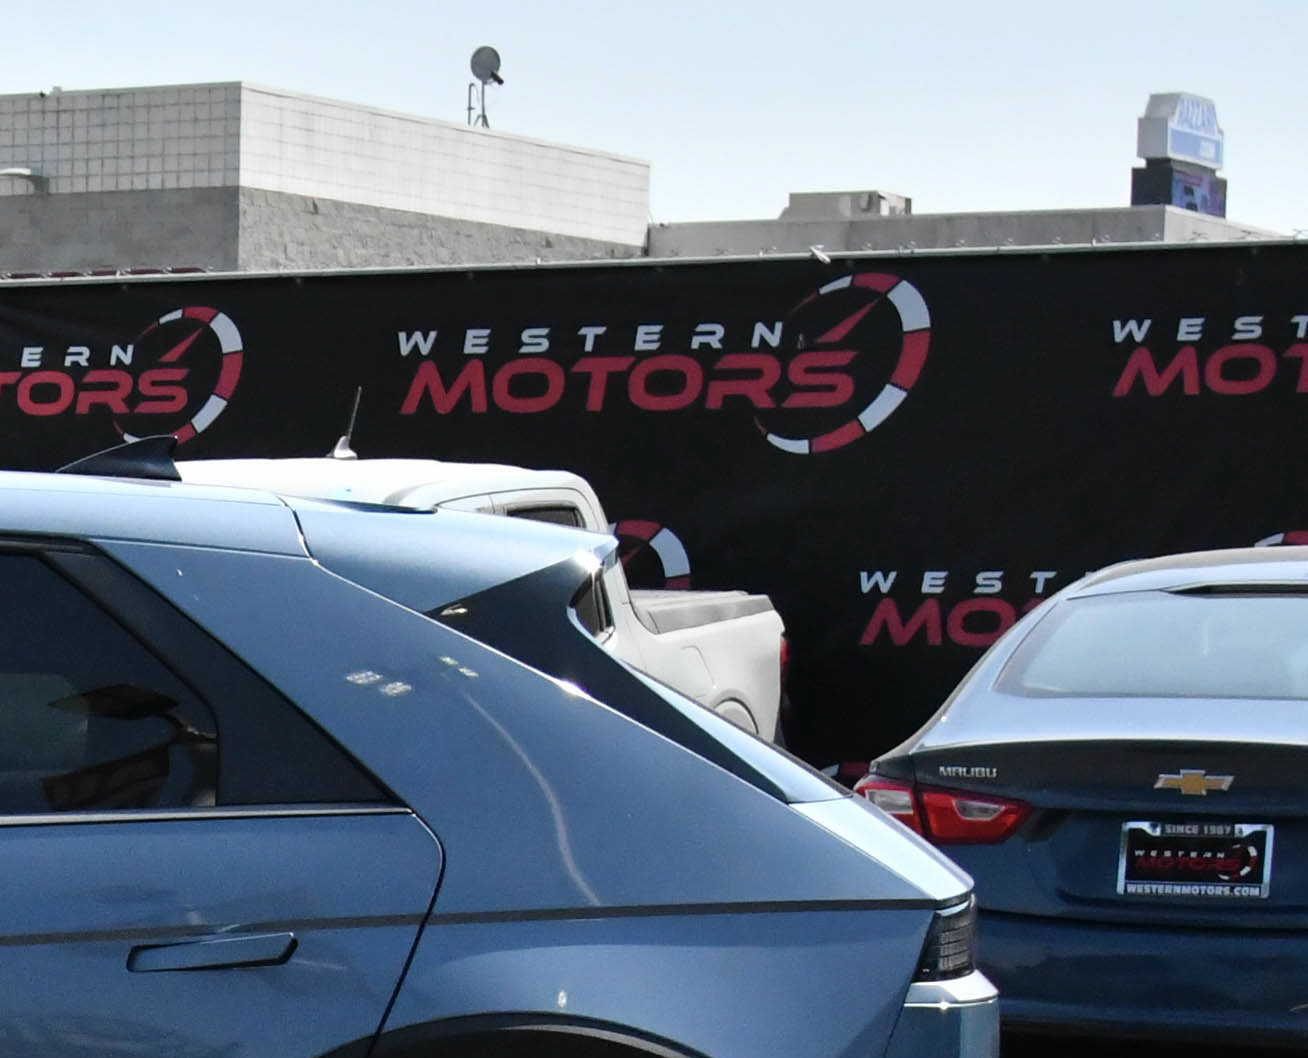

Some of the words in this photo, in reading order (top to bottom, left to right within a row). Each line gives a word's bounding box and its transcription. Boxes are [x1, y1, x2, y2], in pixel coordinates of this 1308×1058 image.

[398, 322, 782, 356] WESTERN
[400, 351, 858, 415] MOTORS
[939, 766, 997, 778] MALIBU
[1165, 824, 1199, 834] SINCE
[1135, 850, 1225, 858] WESTERN
[1126, 884, 1260, 896] WESTERNMOTORS.COM
